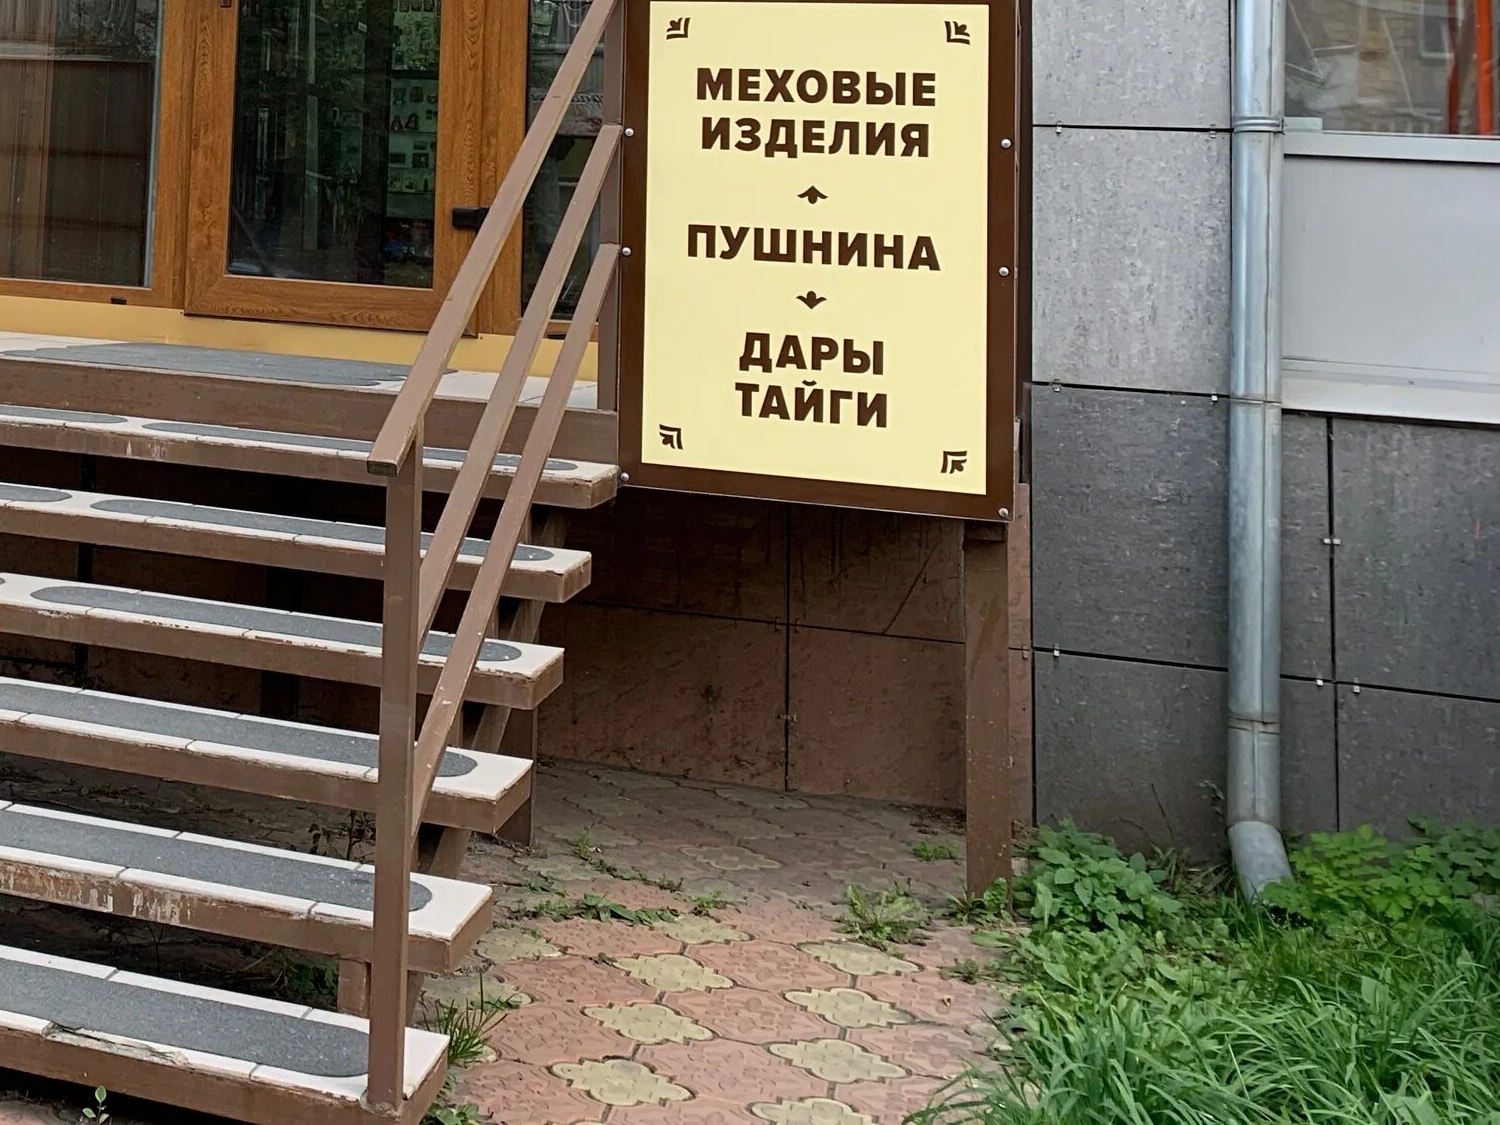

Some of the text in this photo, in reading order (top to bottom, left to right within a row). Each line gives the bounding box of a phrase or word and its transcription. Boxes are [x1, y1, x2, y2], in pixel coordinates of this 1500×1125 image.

[696, 67, 937, 107] МЕХОВЫЕ
[700, 117, 930, 158] ИЗДЕЛИЯ
[687, 224, 941, 271] ПУШНИНА
[738, 332, 885, 375] ДАРЫ
[735, 380, 888, 428] ТАЙГИ
